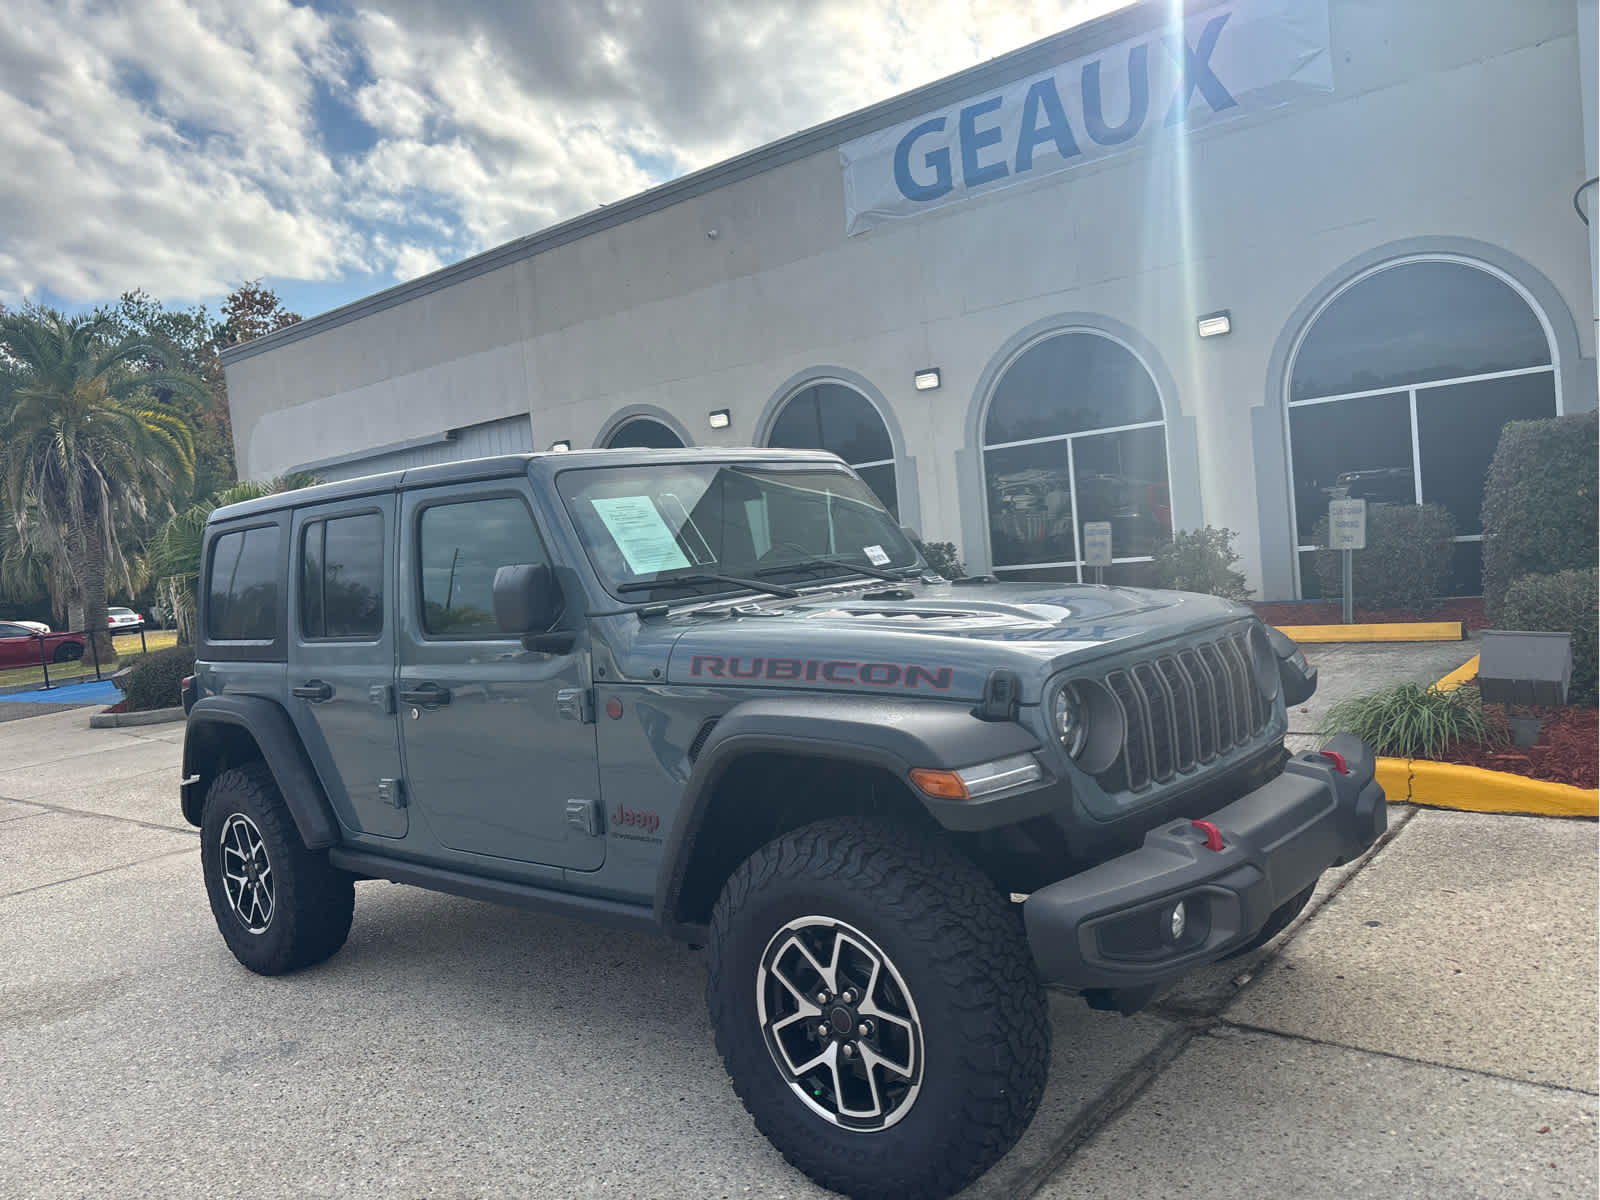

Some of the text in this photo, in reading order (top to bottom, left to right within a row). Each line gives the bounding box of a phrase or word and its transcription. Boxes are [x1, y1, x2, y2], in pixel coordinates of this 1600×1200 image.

[894, 12, 1238, 201] GEAUX
[689, 655, 954, 690] RUBICON
[611, 803, 660, 833] Jeep
